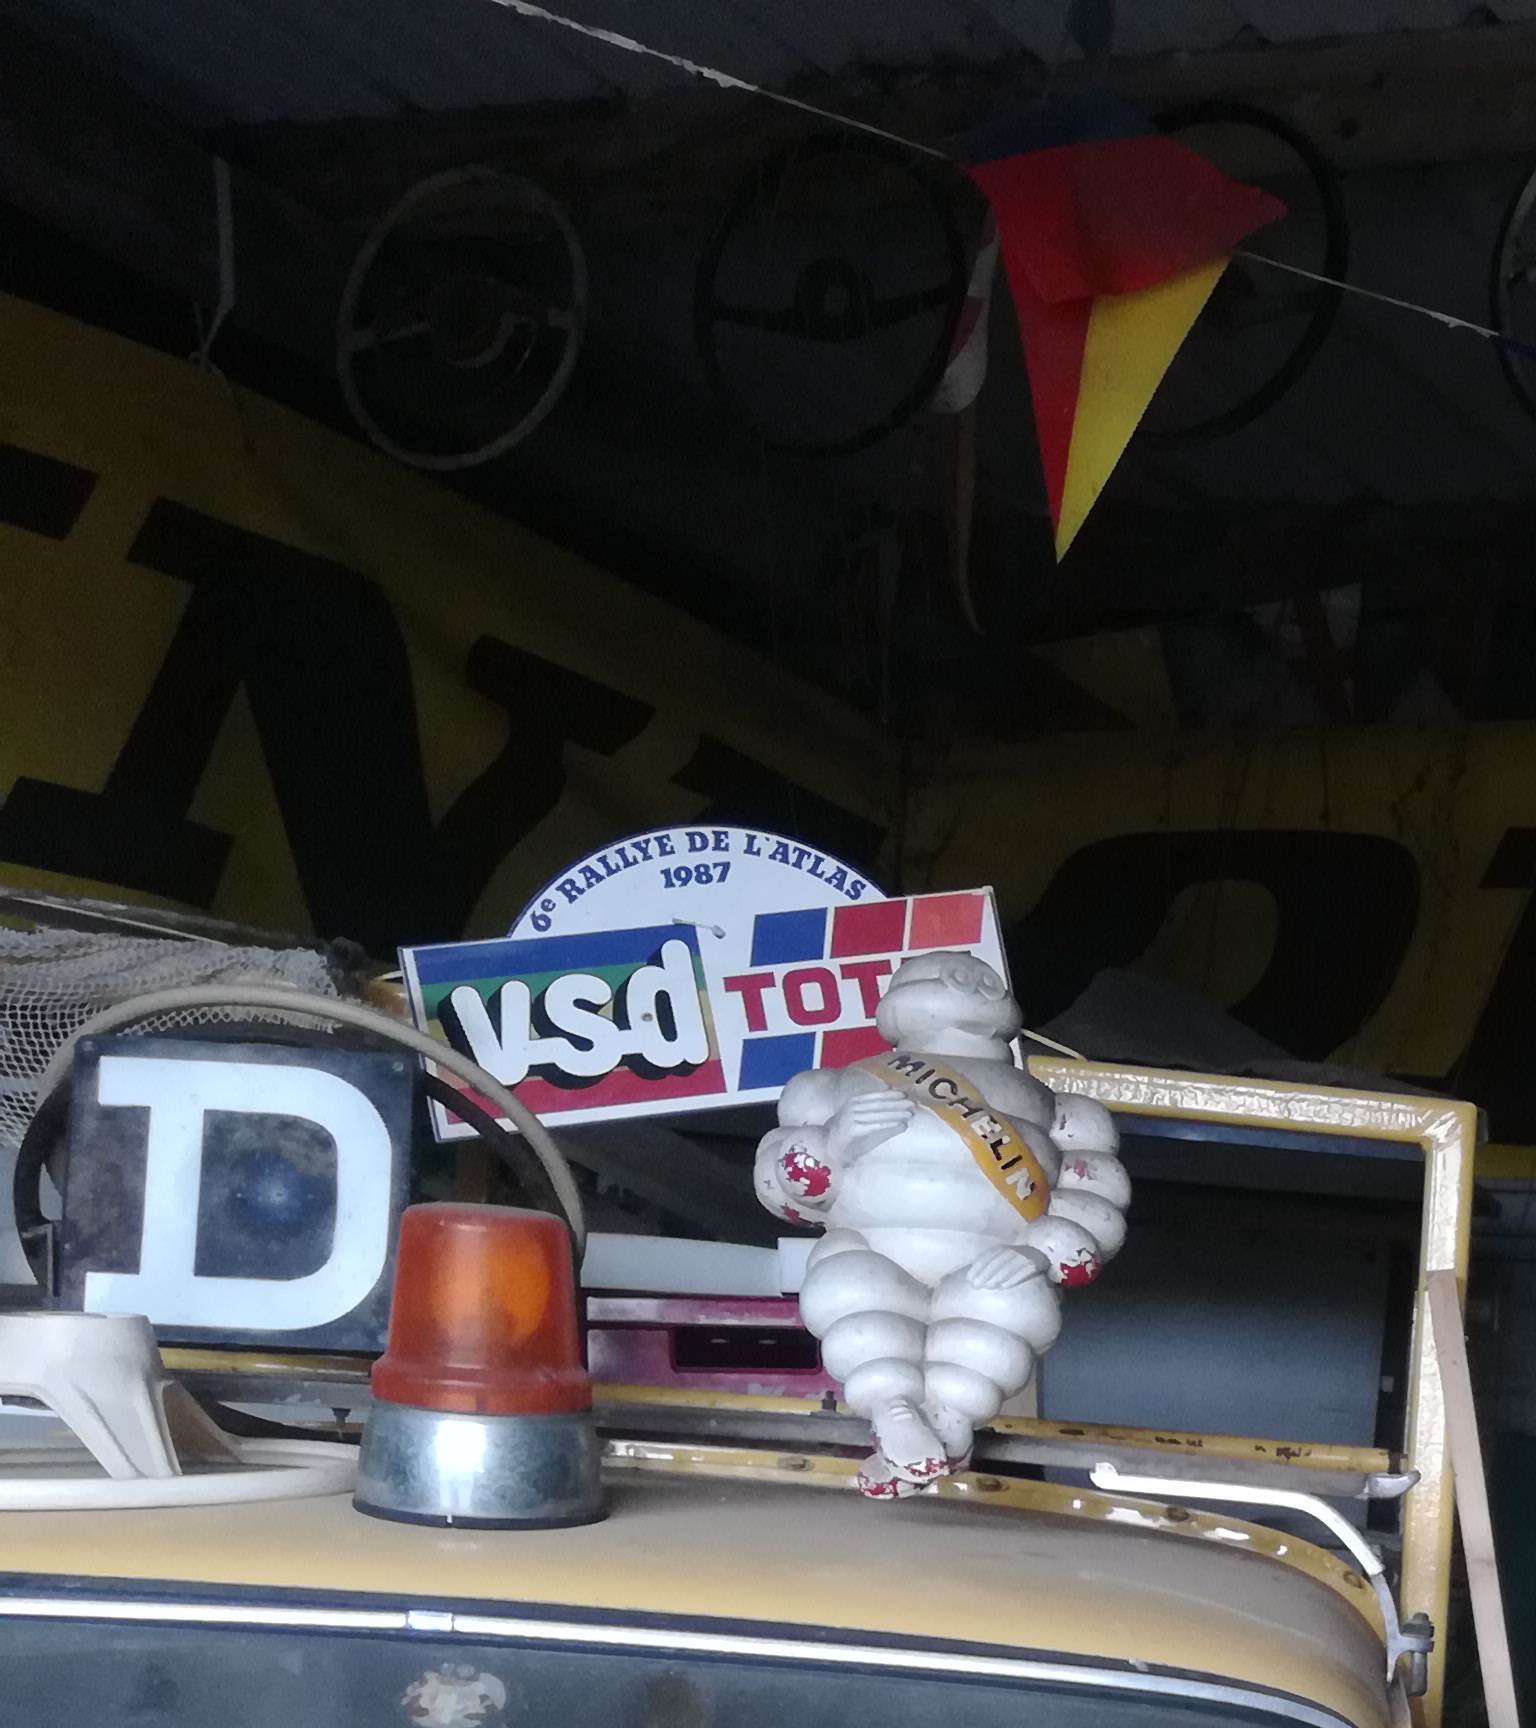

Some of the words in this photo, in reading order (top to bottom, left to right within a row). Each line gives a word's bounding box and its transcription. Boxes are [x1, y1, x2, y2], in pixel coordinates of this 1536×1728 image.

[556, 830, 676, 906] RALLYE
[687, 829, 730, 855] DE
[743, 829, 870, 903] L'ATLAS
[660, 861, 733, 891] 1987
[723, 957, 900, 1034] TOT
[887, 1052, 1037, 1201] MICHELIN
[84, 1055, 393, 1333] D
